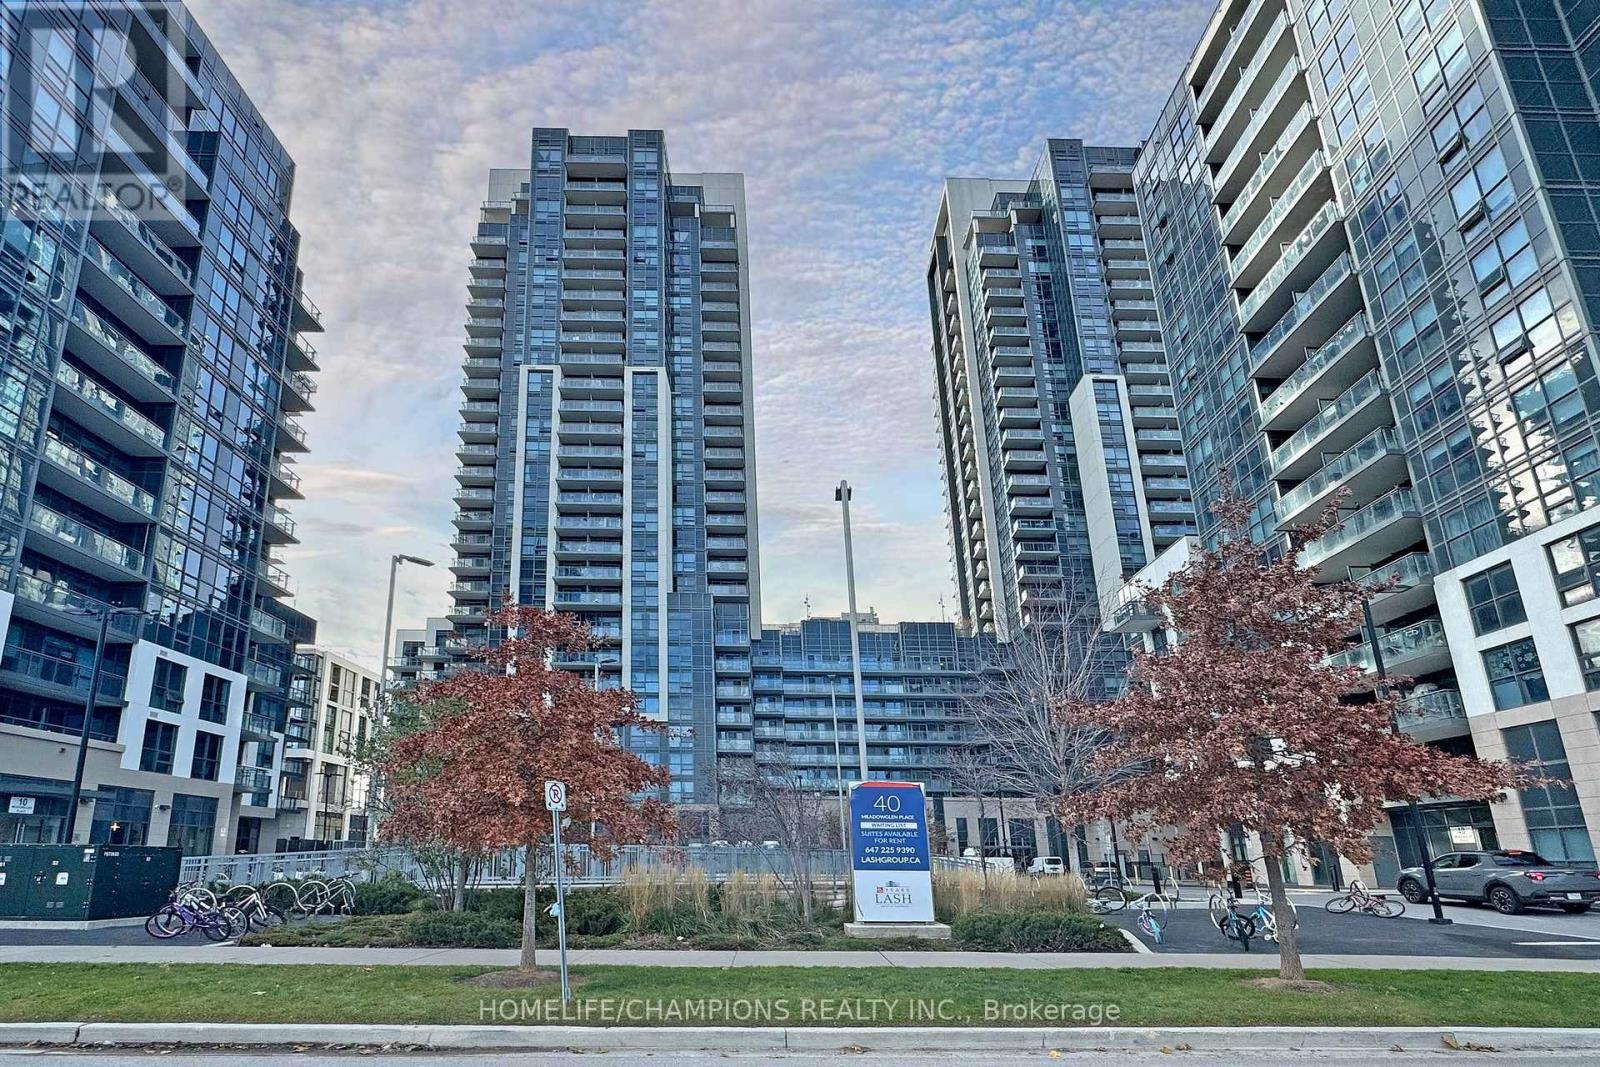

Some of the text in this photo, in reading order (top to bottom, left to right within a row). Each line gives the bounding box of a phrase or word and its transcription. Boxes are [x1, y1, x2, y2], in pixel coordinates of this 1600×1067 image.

[19, 798, 28, 806] 10
[873, 795, 901, 812] 40
[864, 846, 916, 854] 647 225 9390
[861, 856, 921, 864] LASHGROUP.CA
[875, 894, 912, 904] LASH
